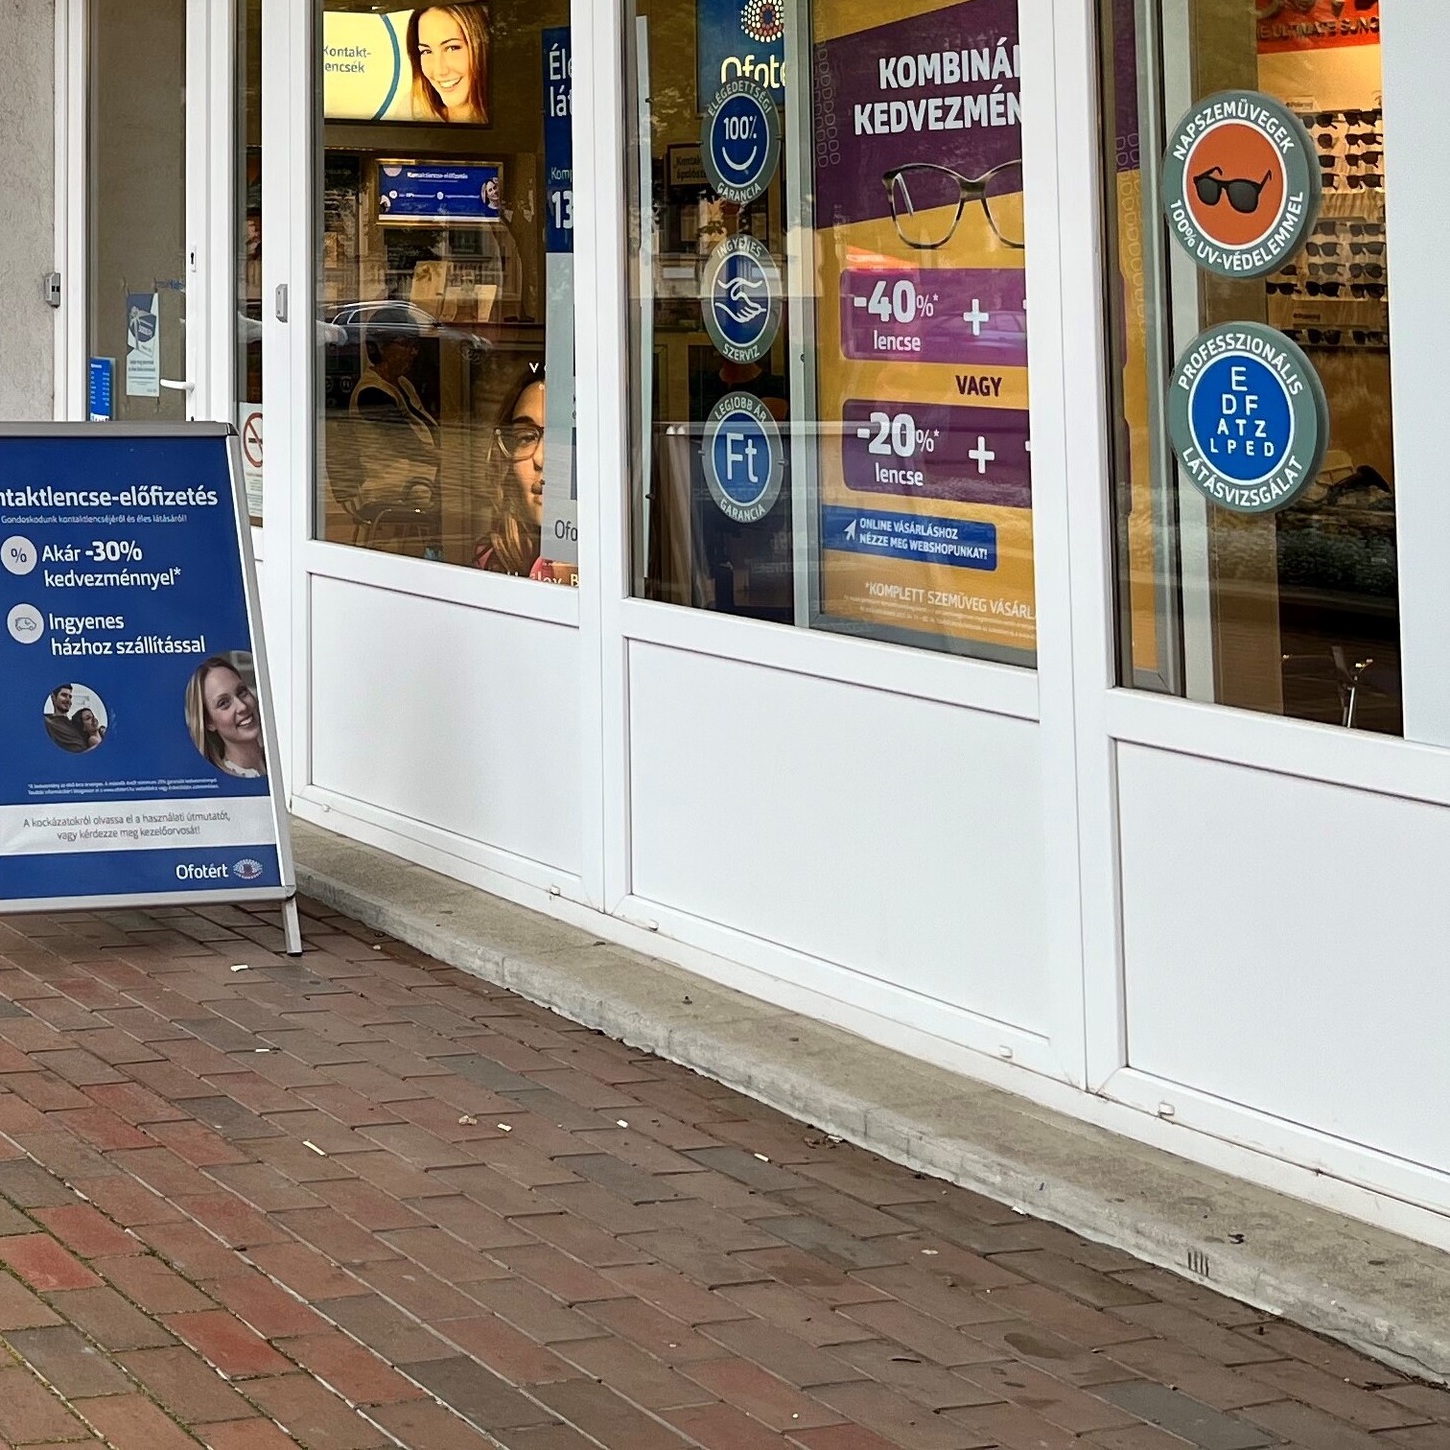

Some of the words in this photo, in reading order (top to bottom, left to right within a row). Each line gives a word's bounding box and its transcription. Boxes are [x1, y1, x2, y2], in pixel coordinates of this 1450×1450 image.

[707, 80, 773, 117] ELÉGEDETTSÉGI
[723, 115, 758, 140] 100%
[1172, 98, 1295, 161] NAPSZEMŰVEGEK
[716, 182, 762, 201] GARANCIA
[1170, 199, 1198, 248] 100%
[1196, 191, 1303, 271] UV-VÉDELEMMEL
[716, 236, 762, 259] INGYENES
[873, 329, 921, 351] lencse
[722, 343, 760, 361] SZERVIZ
[1178, 333, 1304, 396] PROFESSZIONÁLIS
[955, 374, 1003, 397] VAGY
[1231, 366, 1248, 391] E
[714, 396, 753, 420] LEGJOBB
[753, 403, 767, 423] ÁR
[726, 432, 759, 483] Ft
[875, 462, 924, 486] lencse
[1182, 446, 1303, 507] LÁTÁSVIZSGÁLAT
[0, 515, 58, 524] Gondoskodunk
[720, 497, 766, 522] GARANCIA
[859, 517, 892, 532] ONLINE
[893, 520, 959, 540] VÁSÁRLÁSHOZ
[41, 544, 81, 562] Akár
[85, 539, 143, 562] -30%
[859, 531, 889, 547] NÉZZE
[890, 538, 908, 550] MEG
[909, 539, 988, 560] WEBSHOPUNKAT!
[927, 590, 987, 613] SZEMŰVEG
[989, 598, 1036, 620] VÁSÁRL
[48, 613, 125, 635] Ingyenes
[51, 636, 113, 656] házhoz
[116, 635, 206, 655] szállítással
[23, 819, 30, 828] A
[32, 814, 91, 827] kockázatokról
[93, 814, 124, 826] olvassa
[126, 813, 133, 824] el
[135, 816, 141, 824] a
[142, 812, 185, 824] használati
[57, 831, 78, 842] vagy
[79, 829, 118, 839] kérdezze
[120, 830, 139, 840] meg
[176, 860, 229, 880] Ofotért
